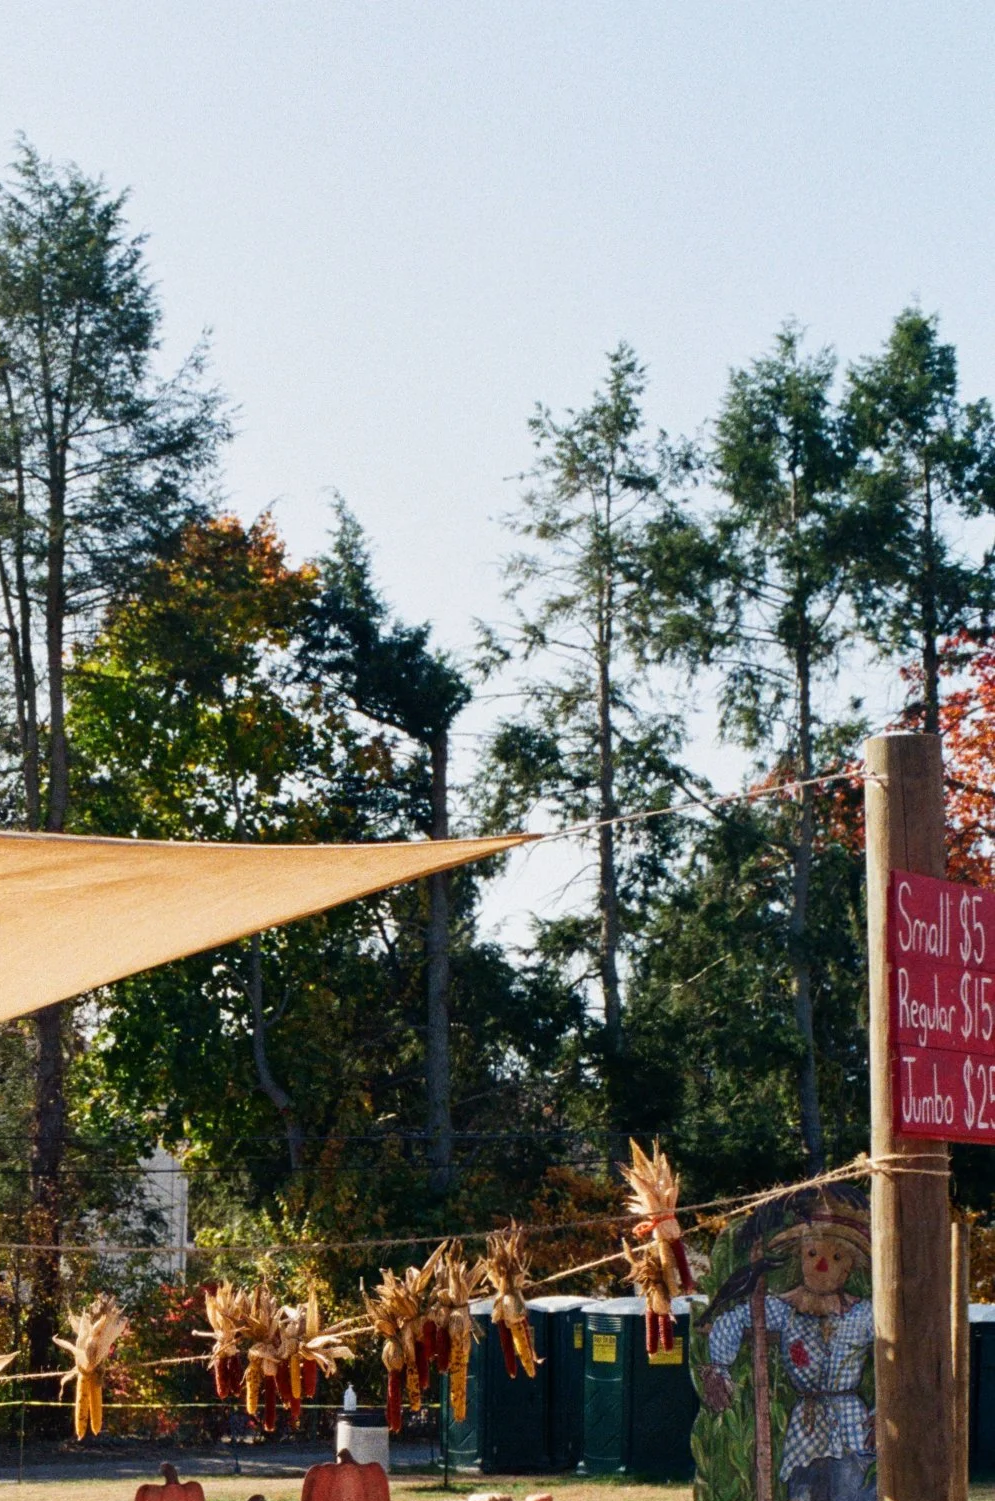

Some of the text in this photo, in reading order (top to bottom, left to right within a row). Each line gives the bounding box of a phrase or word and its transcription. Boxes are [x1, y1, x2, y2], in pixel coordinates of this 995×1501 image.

[898, 881, 985, 966] Small $5
[898, 967, 994, 1047] Regular $15
[902, 1056, 955, 1125] Jumbo
